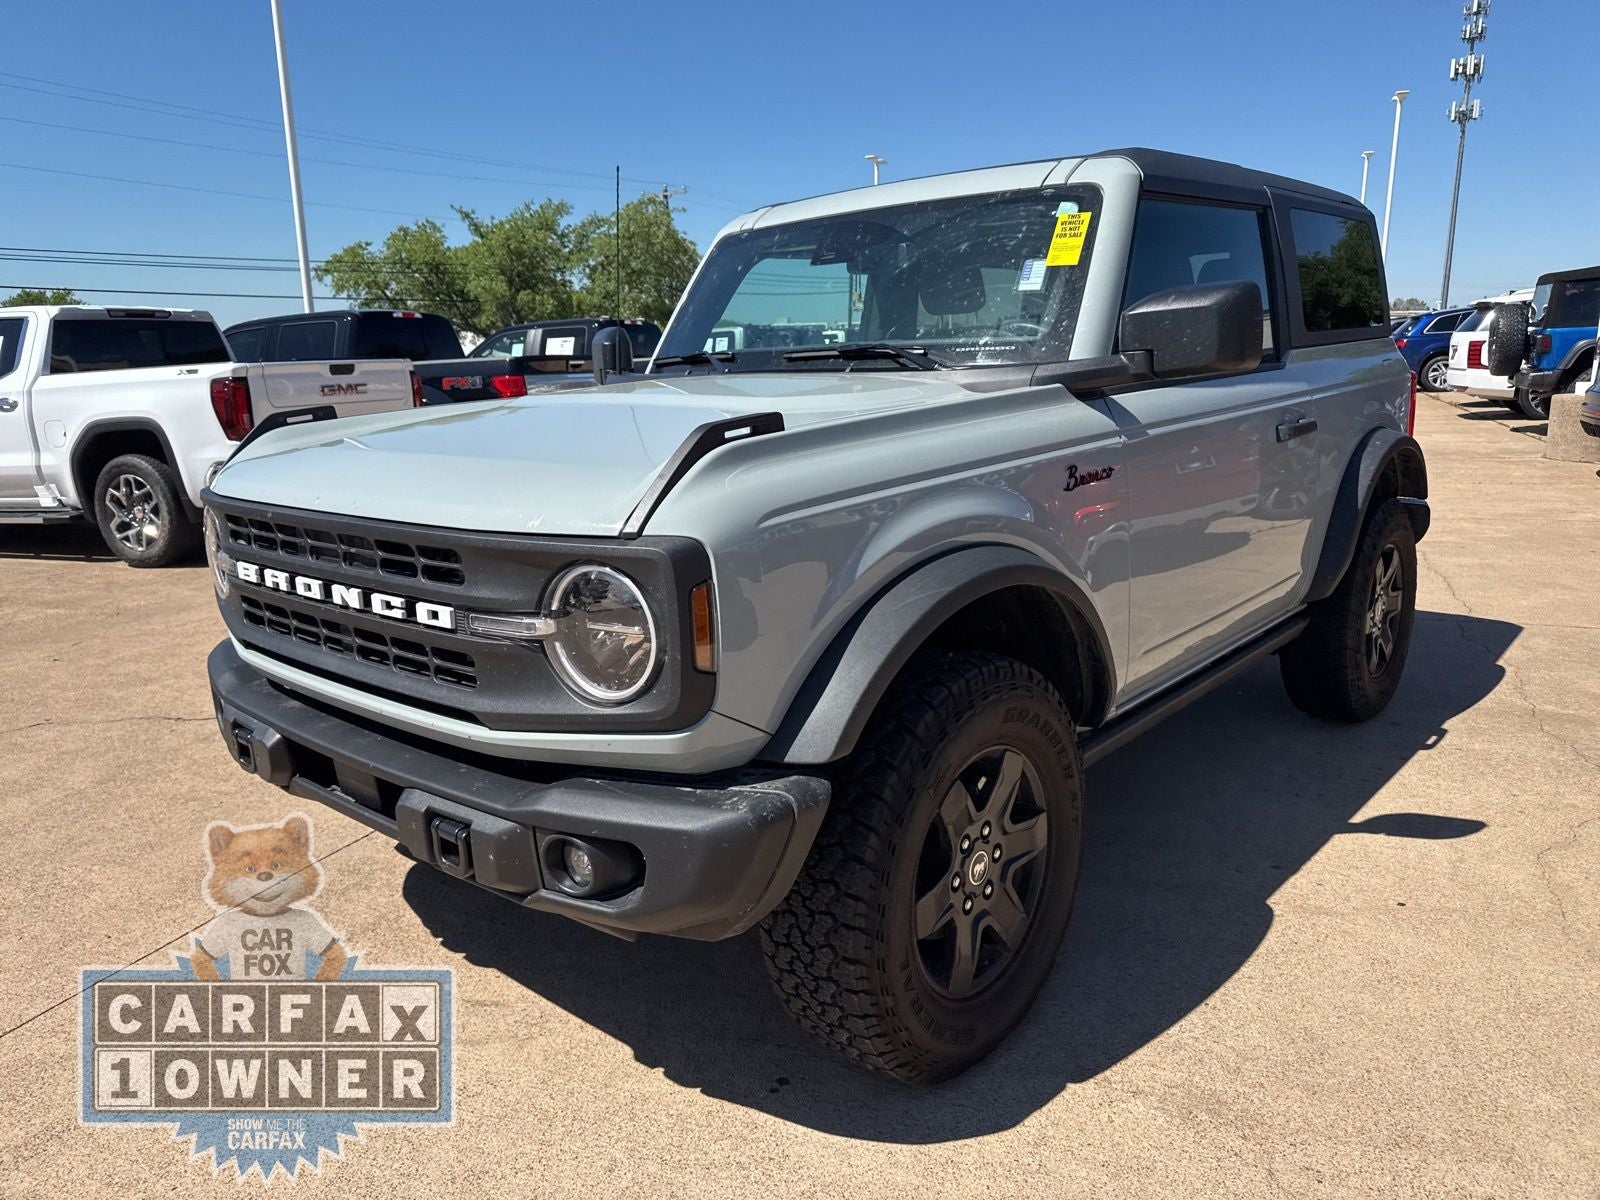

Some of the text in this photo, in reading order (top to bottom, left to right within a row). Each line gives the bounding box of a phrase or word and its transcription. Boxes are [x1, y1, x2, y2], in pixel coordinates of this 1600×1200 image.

[320, 383, 367, 396] GMC
[442, 376, 482, 390] FX4
[1063, 464, 1116, 492] Bronco
[236, 560, 456, 630] BRONCO
[1000, 706, 1074, 781] GRABBER
